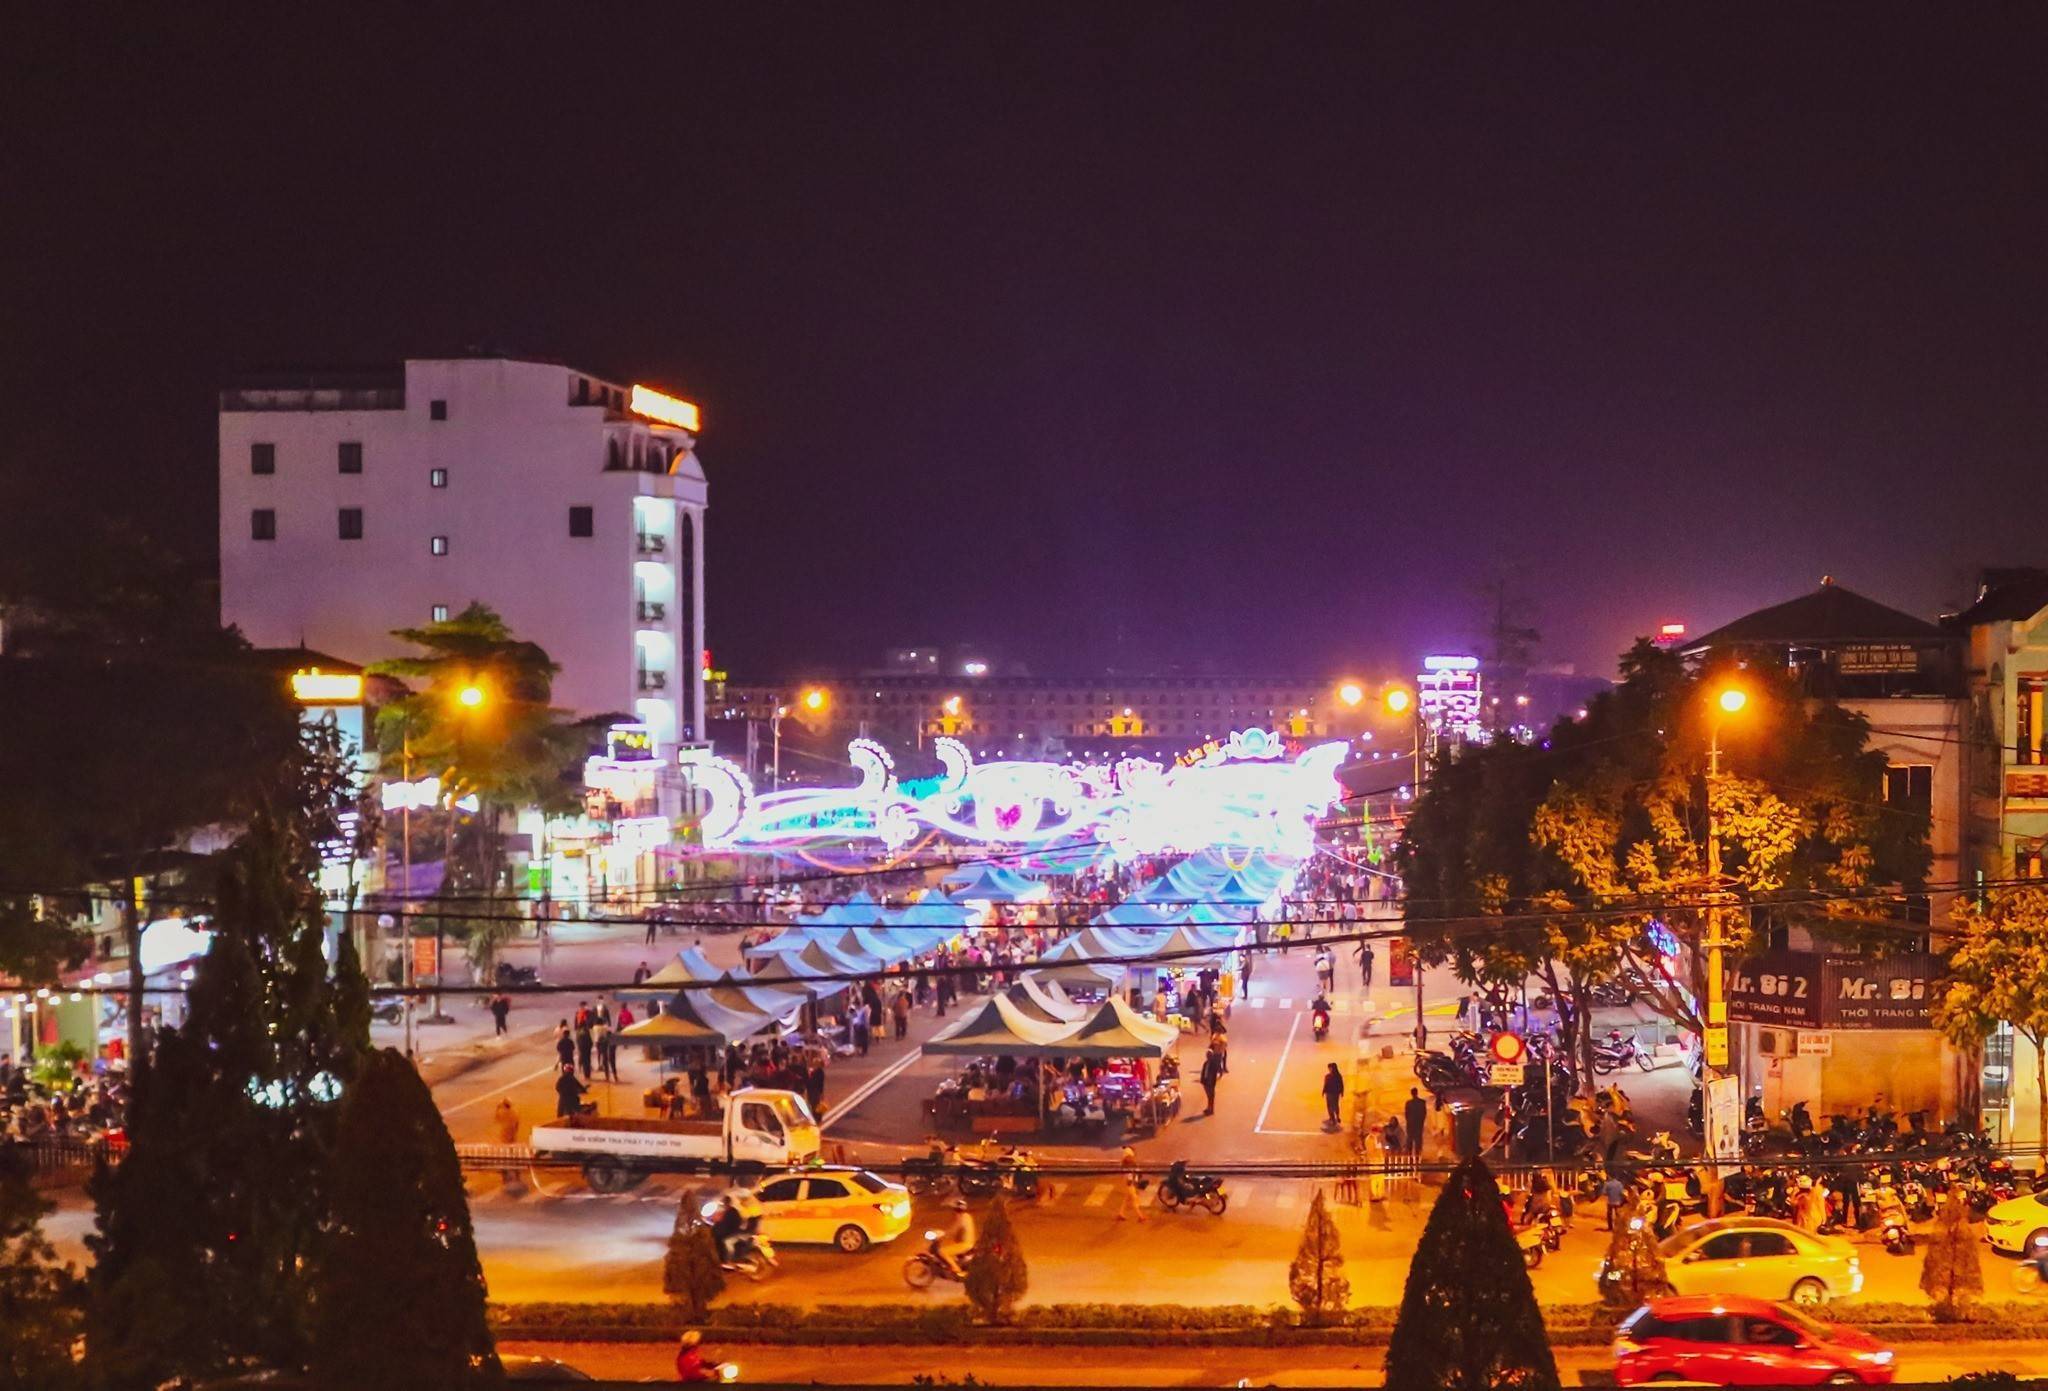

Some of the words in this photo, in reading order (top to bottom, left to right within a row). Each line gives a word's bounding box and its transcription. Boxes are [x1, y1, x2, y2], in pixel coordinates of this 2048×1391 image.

[1794, 976, 1808, 998] 2
[1838, 977, 1882, 1000] Mr.
[1748, 1002, 1780, 1014] TRANG
[1784, 1006, 1806, 1016] NAM
[1873, 1008, 1914, 1018] TRANG
